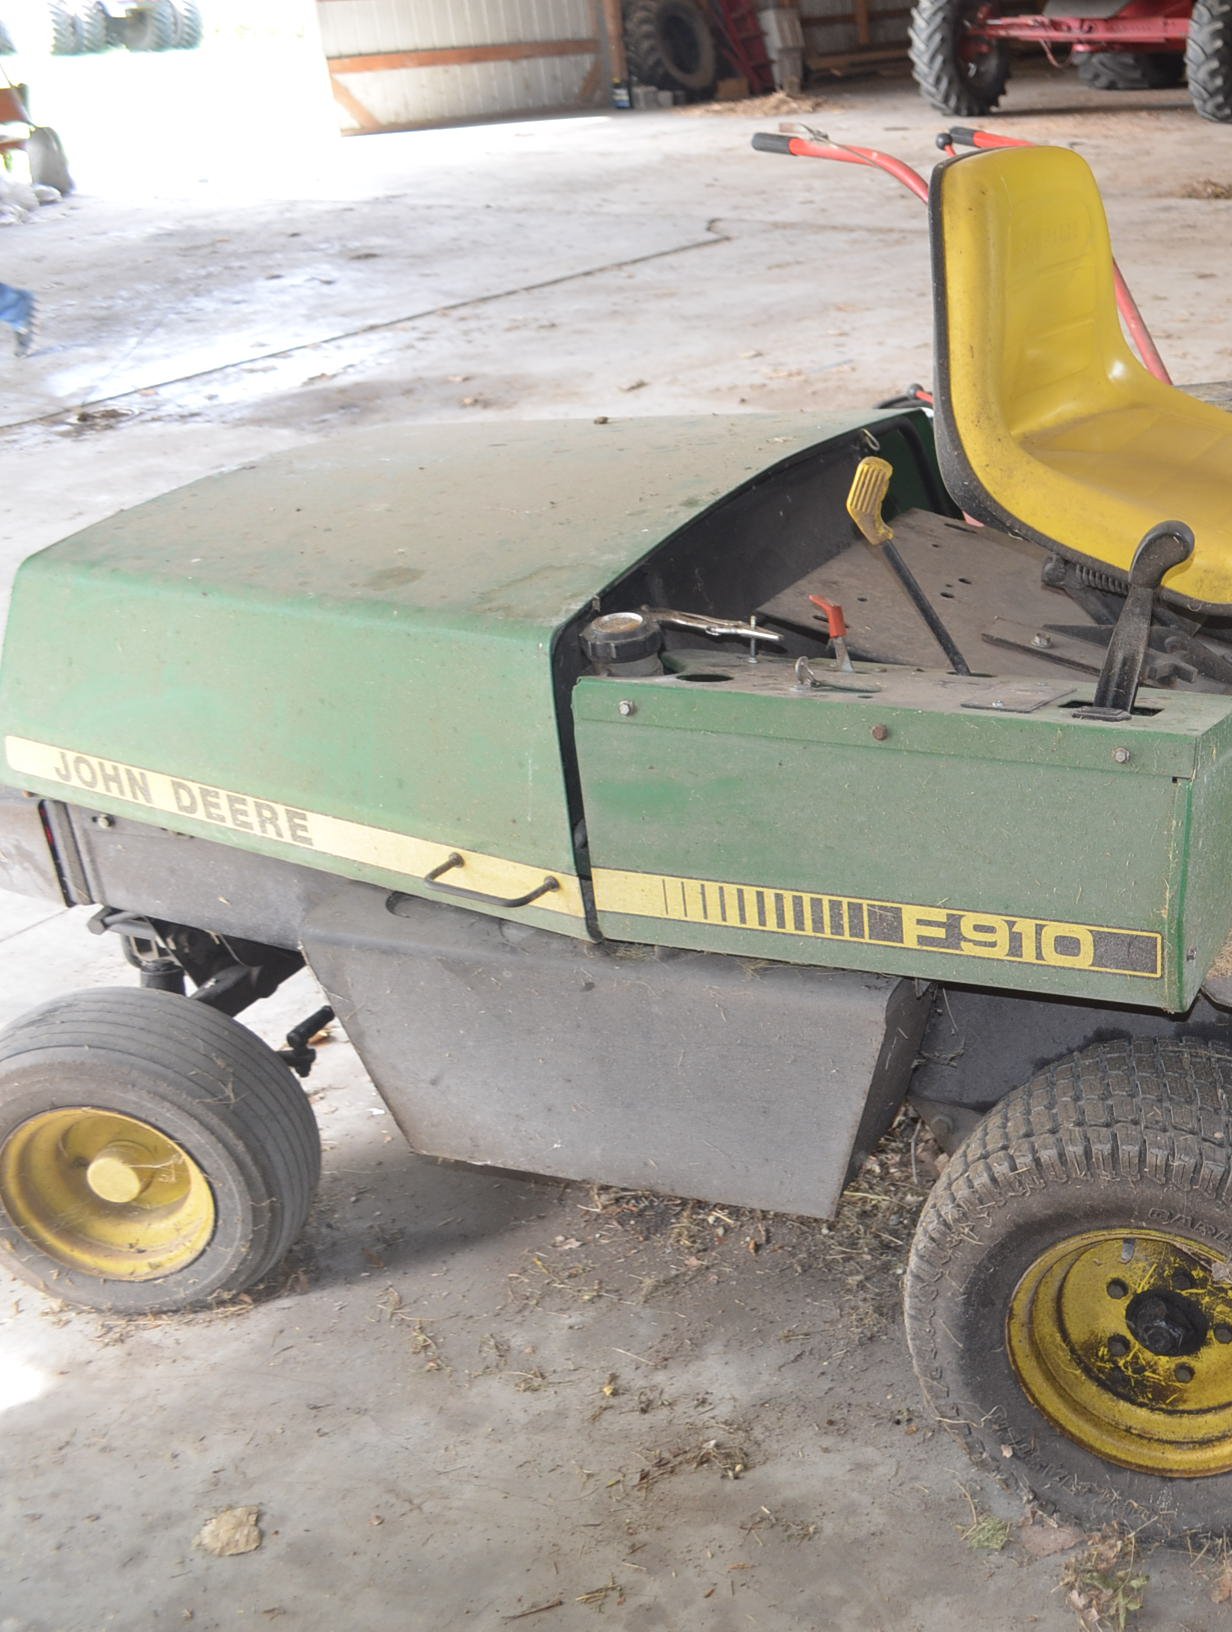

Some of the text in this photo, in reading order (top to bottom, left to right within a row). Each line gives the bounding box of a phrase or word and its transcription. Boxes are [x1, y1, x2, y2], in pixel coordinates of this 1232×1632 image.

[54, 751, 315, 847] JOHN DEERE
[902, 906, 1095, 968] F910
